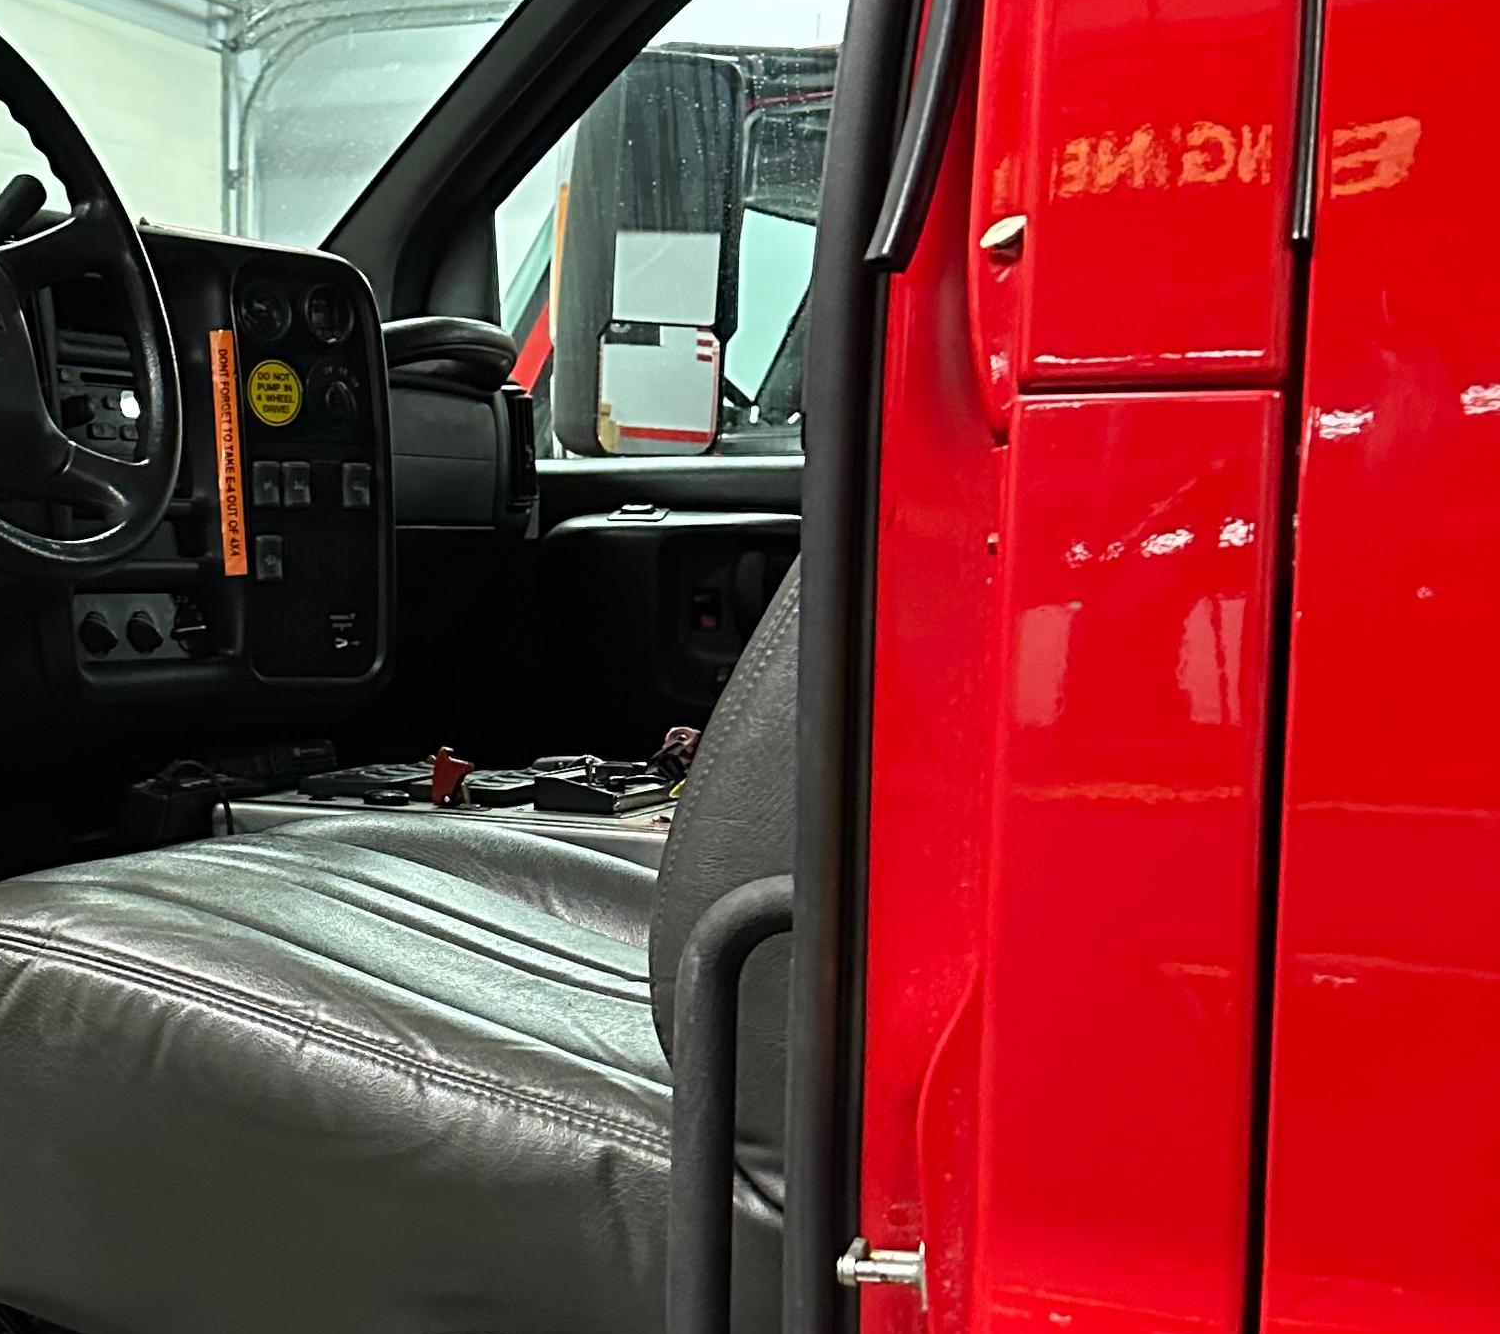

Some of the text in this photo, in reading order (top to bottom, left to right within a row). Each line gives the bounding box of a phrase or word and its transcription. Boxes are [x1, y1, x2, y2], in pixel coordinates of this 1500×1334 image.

[257, 371, 290, 381] DO NOT
[257, 382, 293, 392] PUMP IN
[220, 381, 232, 424] FORGET
[265, 394, 294, 403] WHEEL
[223, 427, 233, 442] TO
[225, 445, 235, 474] TAKE
[227, 495, 238, 518] OUT
[228, 520, 239, 535] OF
